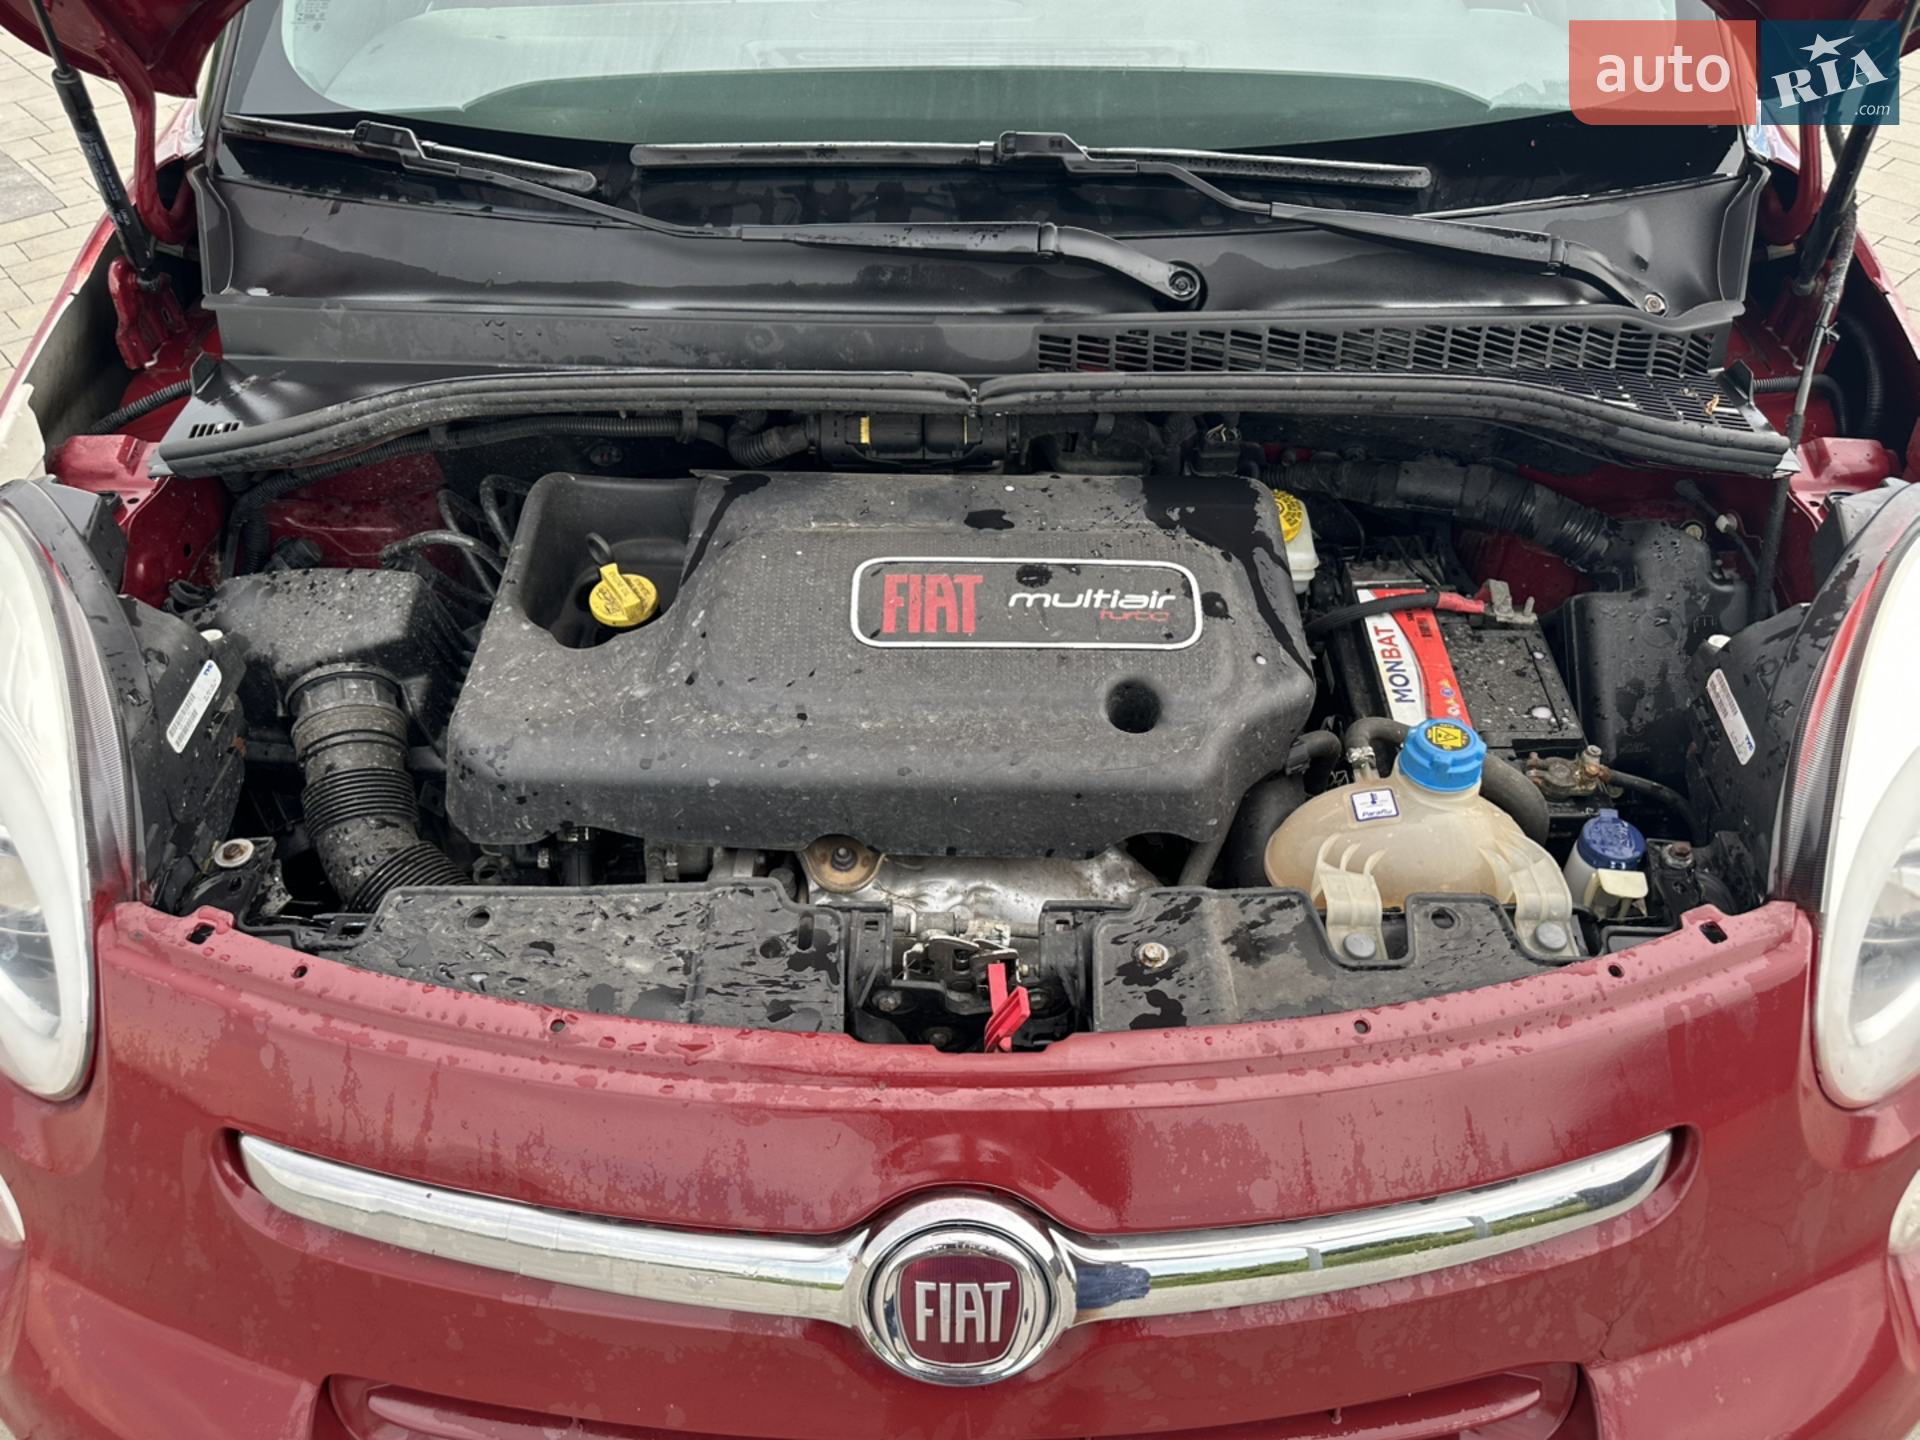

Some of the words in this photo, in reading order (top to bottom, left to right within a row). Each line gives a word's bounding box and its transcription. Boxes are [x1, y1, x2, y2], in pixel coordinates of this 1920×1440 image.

[882, 574, 984, 633] FIAT
[1008, 588, 1176, 609] multiair
[1100, 610, 1170, 622] turbo
[1373, 625, 1416, 704] MONBAT
[1362, 809, 1392, 818] Paraflu
[915, 1280, 1012, 1344] FIAT
